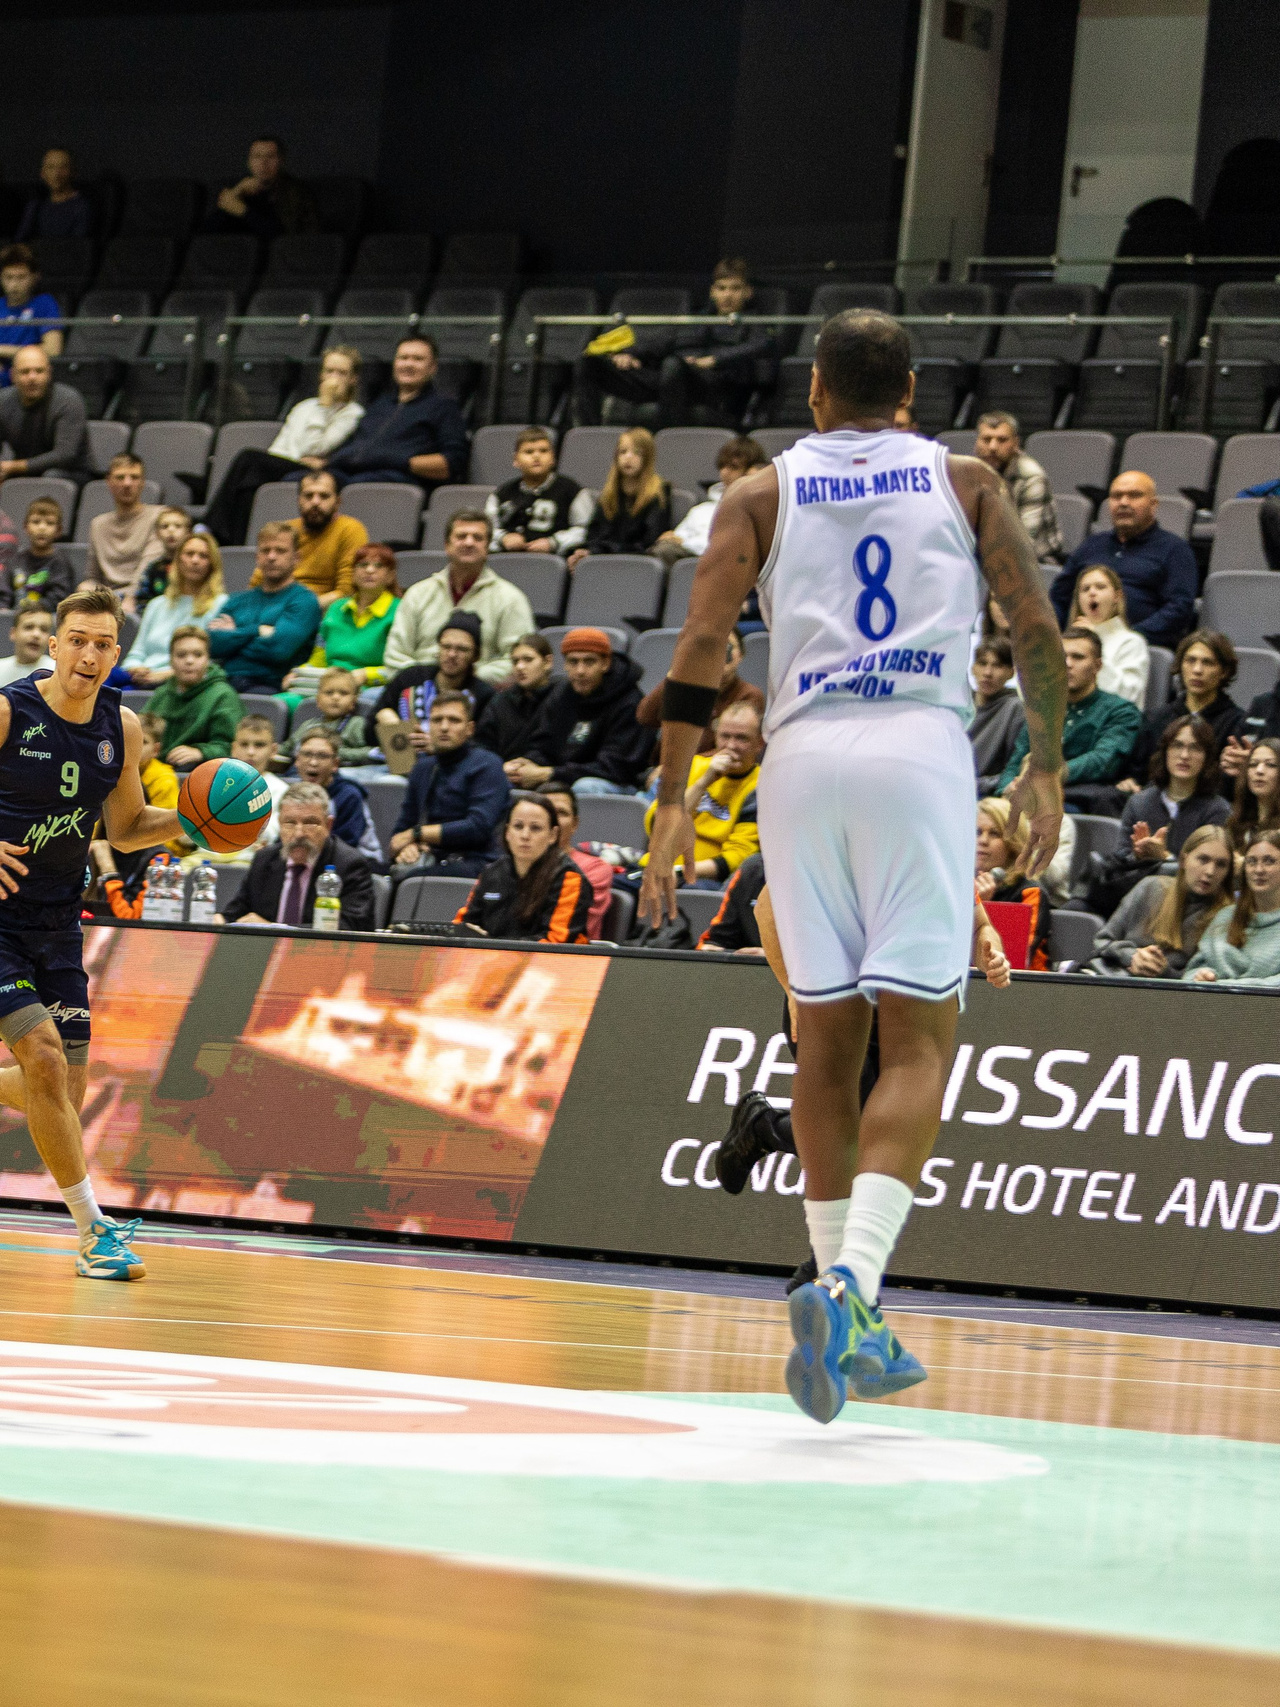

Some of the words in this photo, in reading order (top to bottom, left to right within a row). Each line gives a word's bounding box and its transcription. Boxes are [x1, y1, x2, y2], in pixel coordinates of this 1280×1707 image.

[795, 466, 932, 506] RATHAN-MAYES
[853, 533, 897, 642] 8
[19, 747, 52, 761] Kempa
[60, 761, 80, 797] 9
[960, 1161, 1142, 1222] HOTEL
[1154, 1176, 1280, 1234] AND
